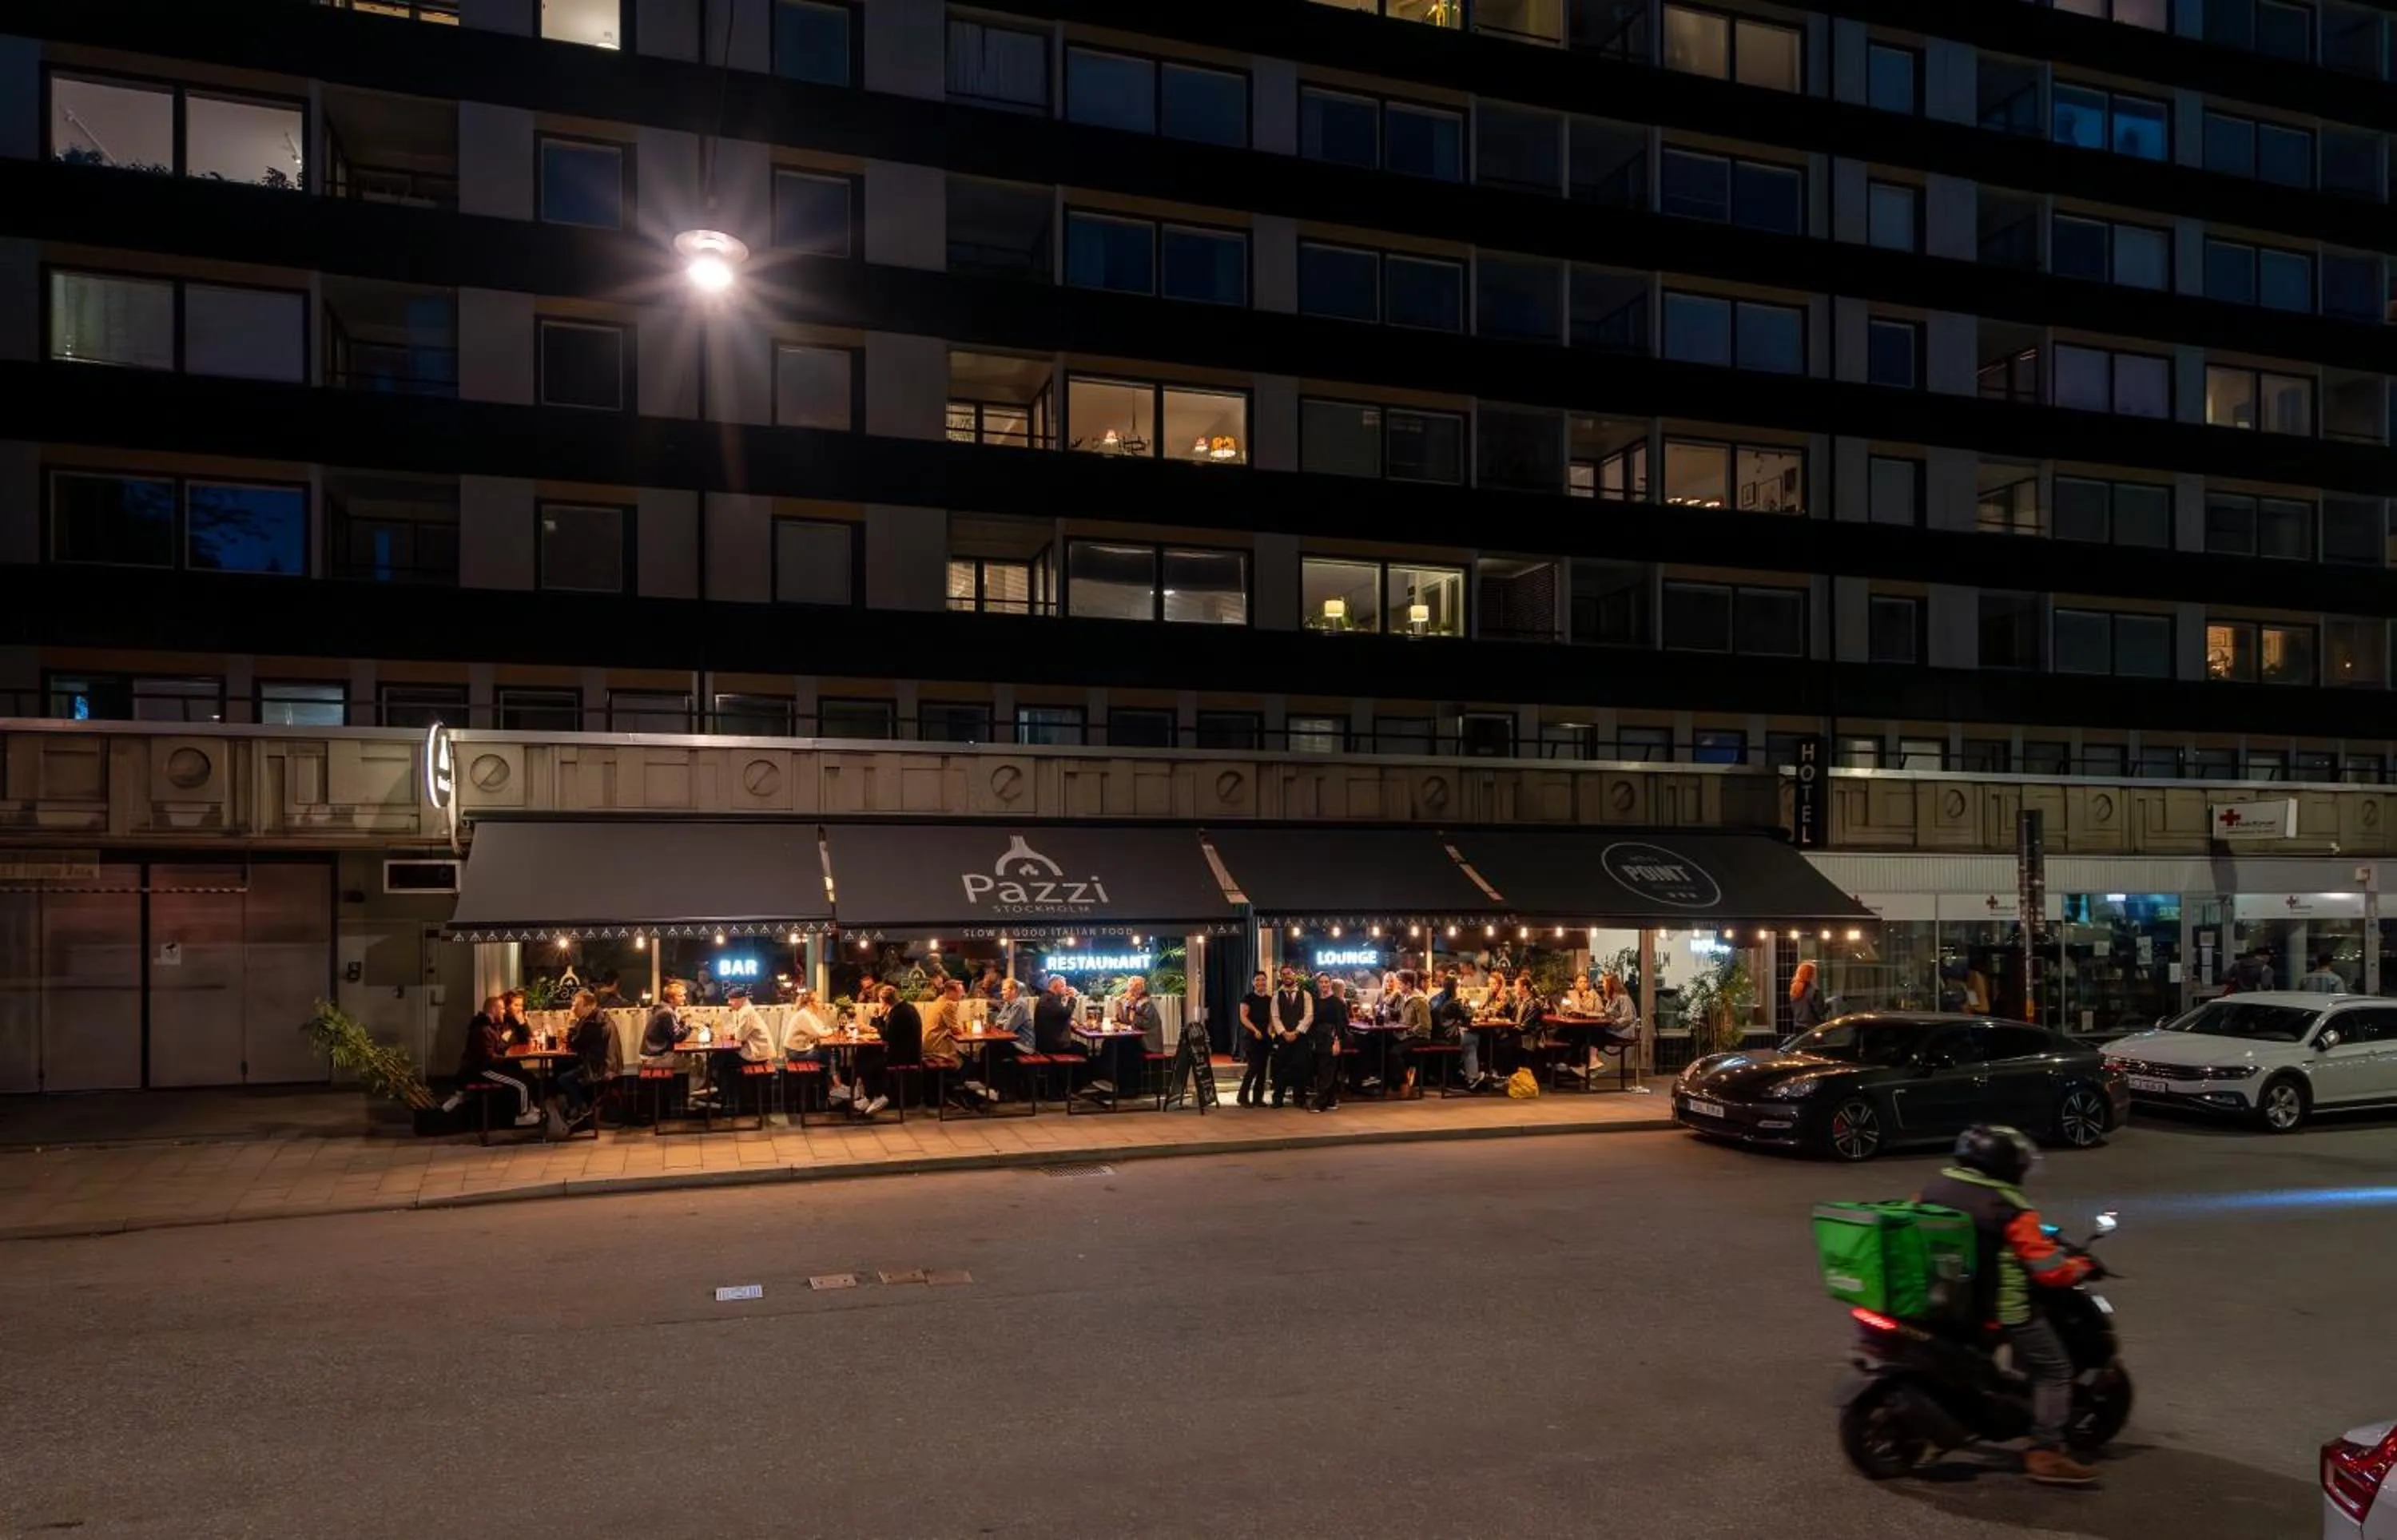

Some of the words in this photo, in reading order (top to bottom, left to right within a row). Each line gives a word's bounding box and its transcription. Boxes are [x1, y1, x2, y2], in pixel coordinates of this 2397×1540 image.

[1799, 742, 1816, 843] HOTEL
[1621, 865, 1692, 882] POINT
[962, 874, 1109, 903] Pazzi
[993, 904, 1091, 913] STOCKHOLM
[1012, 928, 1046, 937] GOOD
[1051, 927, 1097, 937] ITALIAN
[1047, 955, 1152, 970] RESTAURANT
[1316, 951, 1377, 965] LOUNGE
[718, 959, 758, 975] BAR
